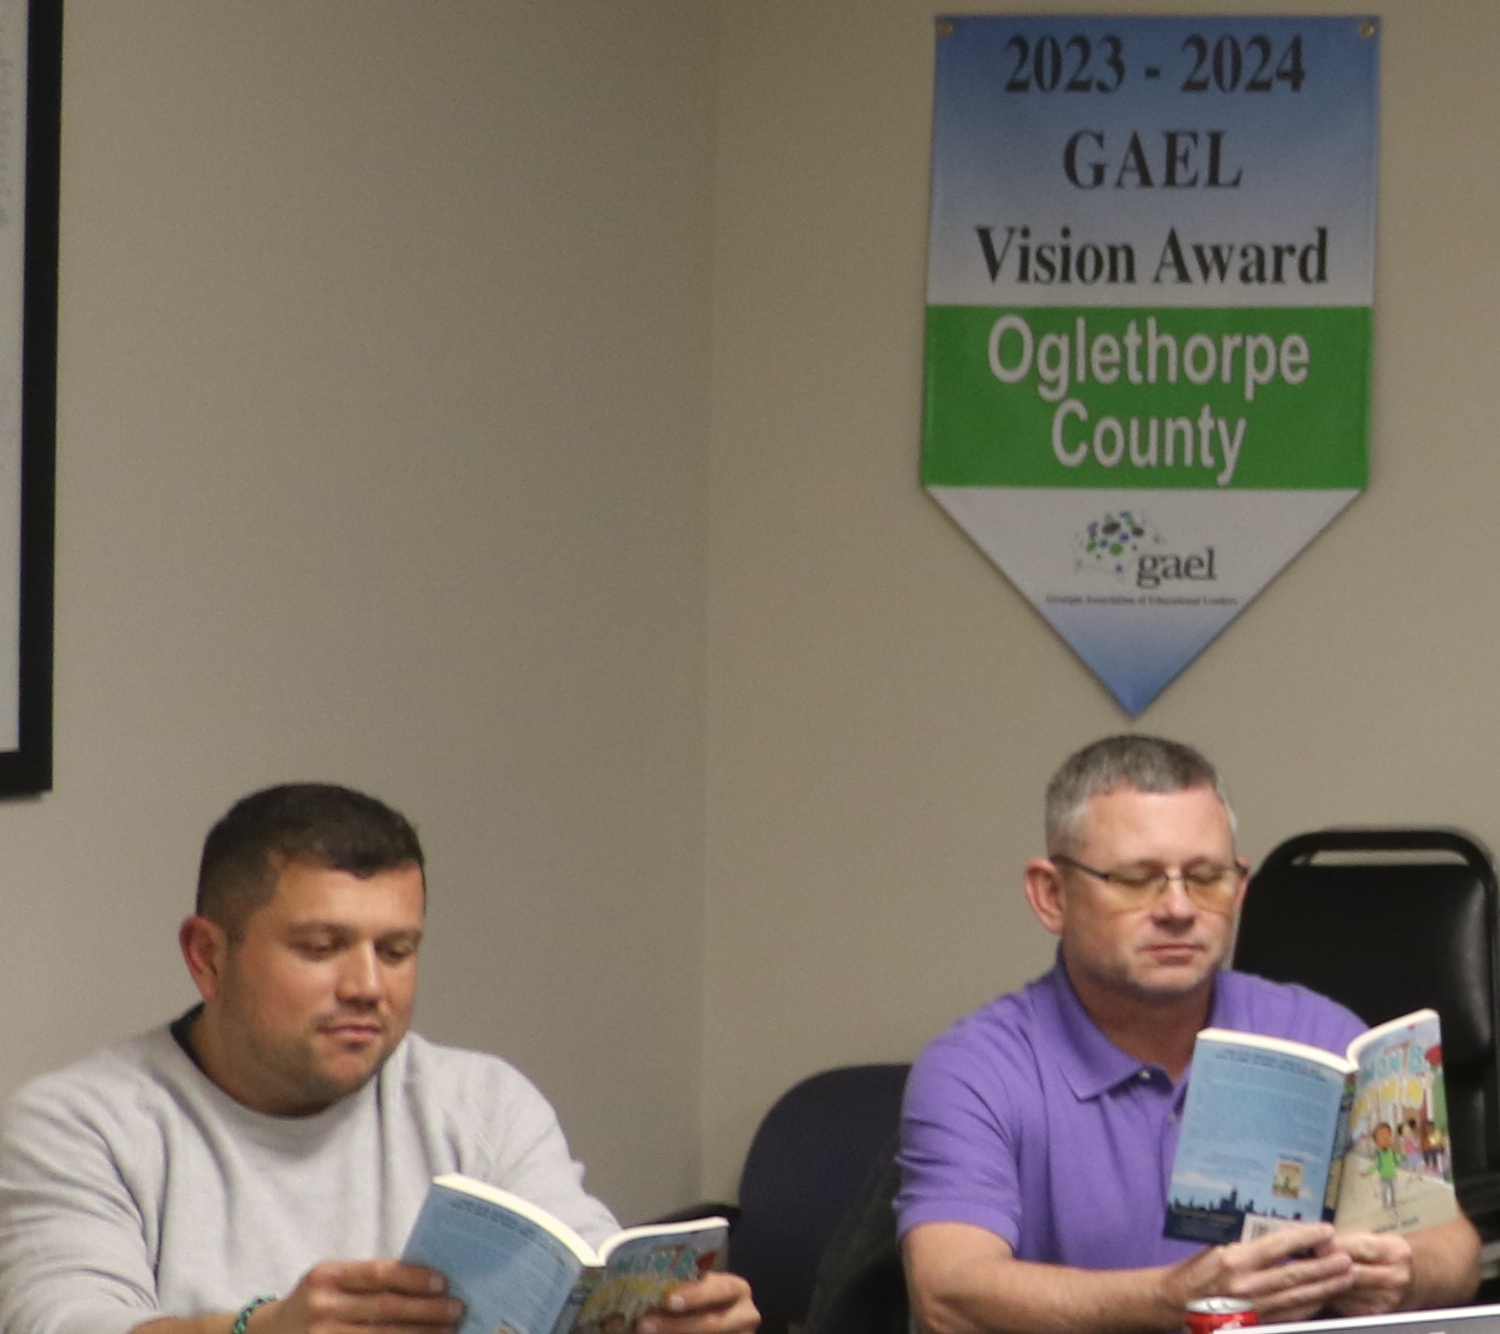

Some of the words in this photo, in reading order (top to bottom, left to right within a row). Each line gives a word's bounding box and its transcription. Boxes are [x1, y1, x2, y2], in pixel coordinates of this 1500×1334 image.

[1004, 34, 1125, 93] 2023
[1181, 34, 1306, 93] 2024
[1062, 130, 1243, 190] GAEL
[975, 226, 1136, 285] Vision
[1153, 226, 1329, 285] Award
[987, 315, 1310, 403] Oglethorpe
[1051, 399, 1247, 486] County
[1136, 548, 1217, 589] gael
